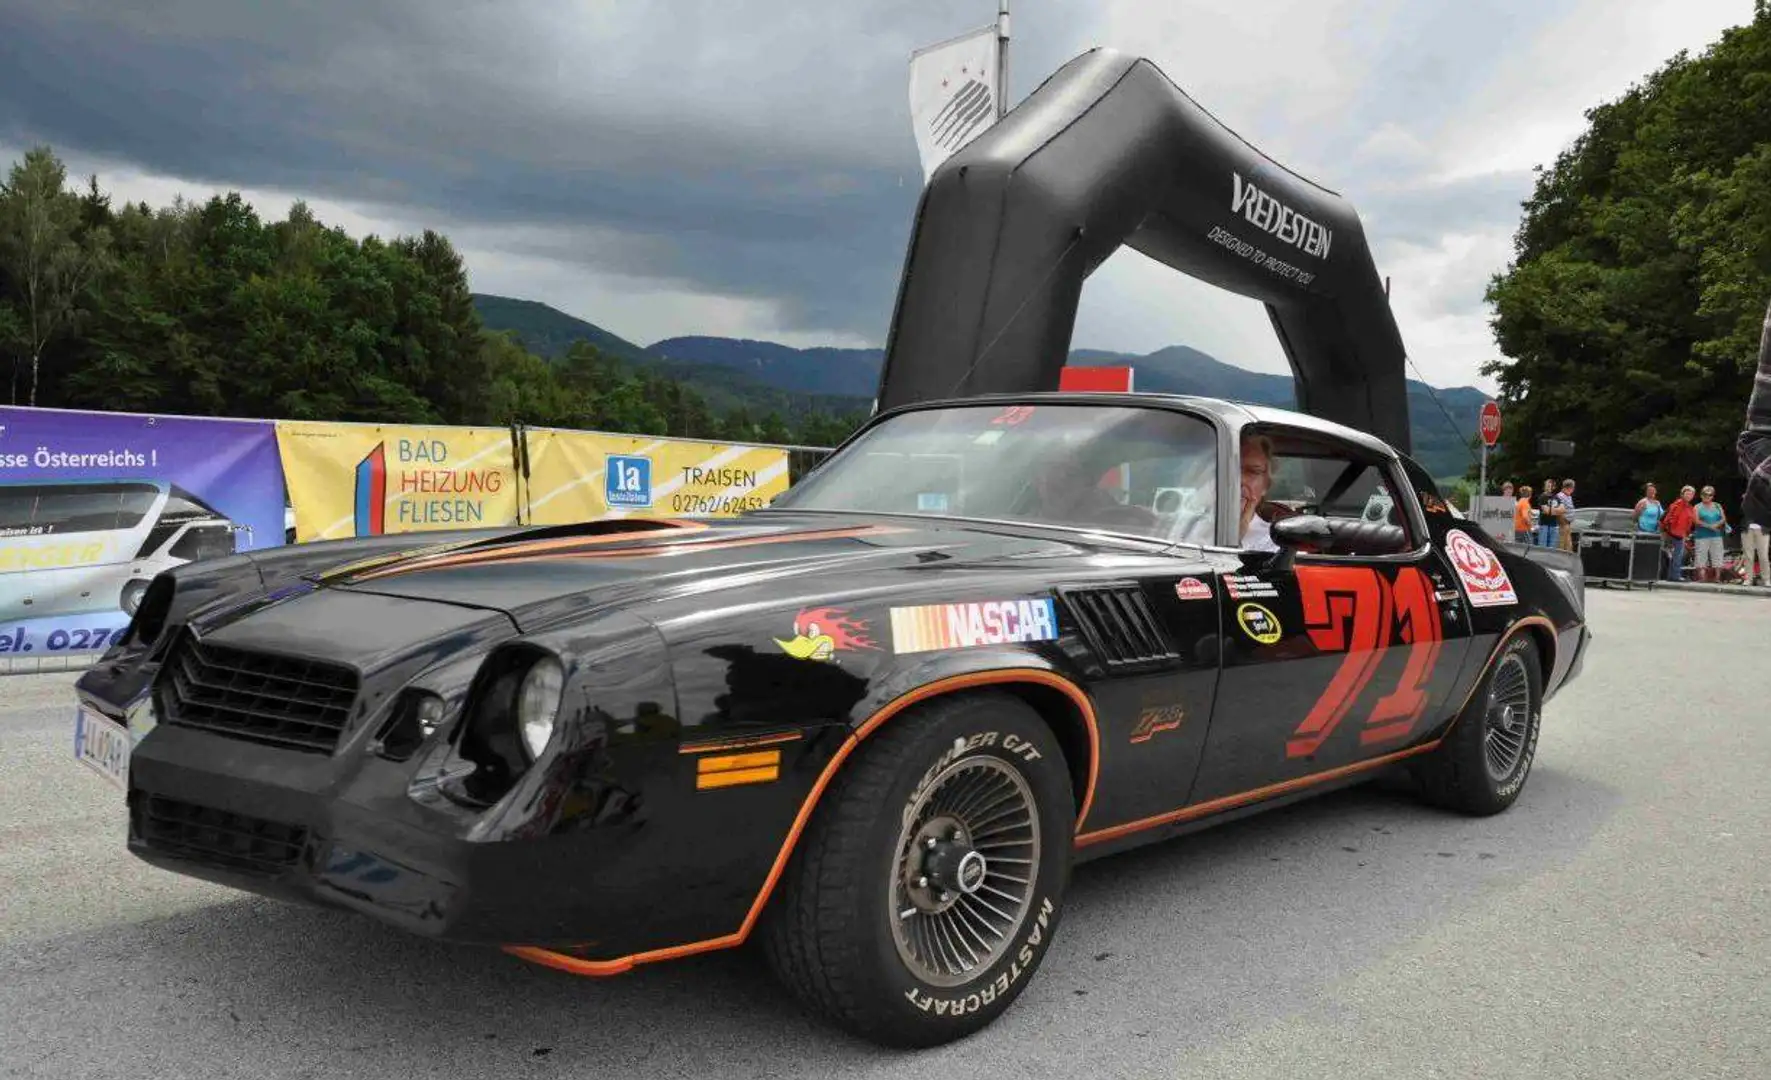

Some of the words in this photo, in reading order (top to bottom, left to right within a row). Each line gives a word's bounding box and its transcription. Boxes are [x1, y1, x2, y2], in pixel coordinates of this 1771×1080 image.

[1231, 171, 1332, 260] VREDESTEIN
[1207, 226, 1254, 257] DESIGNED
[1250, 249, 1267, 263] TO
[1262, 256, 1300, 278] PROTECT
[1483, 415, 1498, 431] STOP
[34, 447, 145, 467] Österreichs
[399, 439, 447, 462] BAD
[401, 470, 502, 493] HEIZUNG
[682, 466, 756, 487] TRAISEN
[400, 500, 482, 524] FLIESEN
[945, 598, 1054, 649] NASCAR
[1286, 564, 1443, 758] 71
[904, 897, 1054, 1016] MASTERCRAFT
